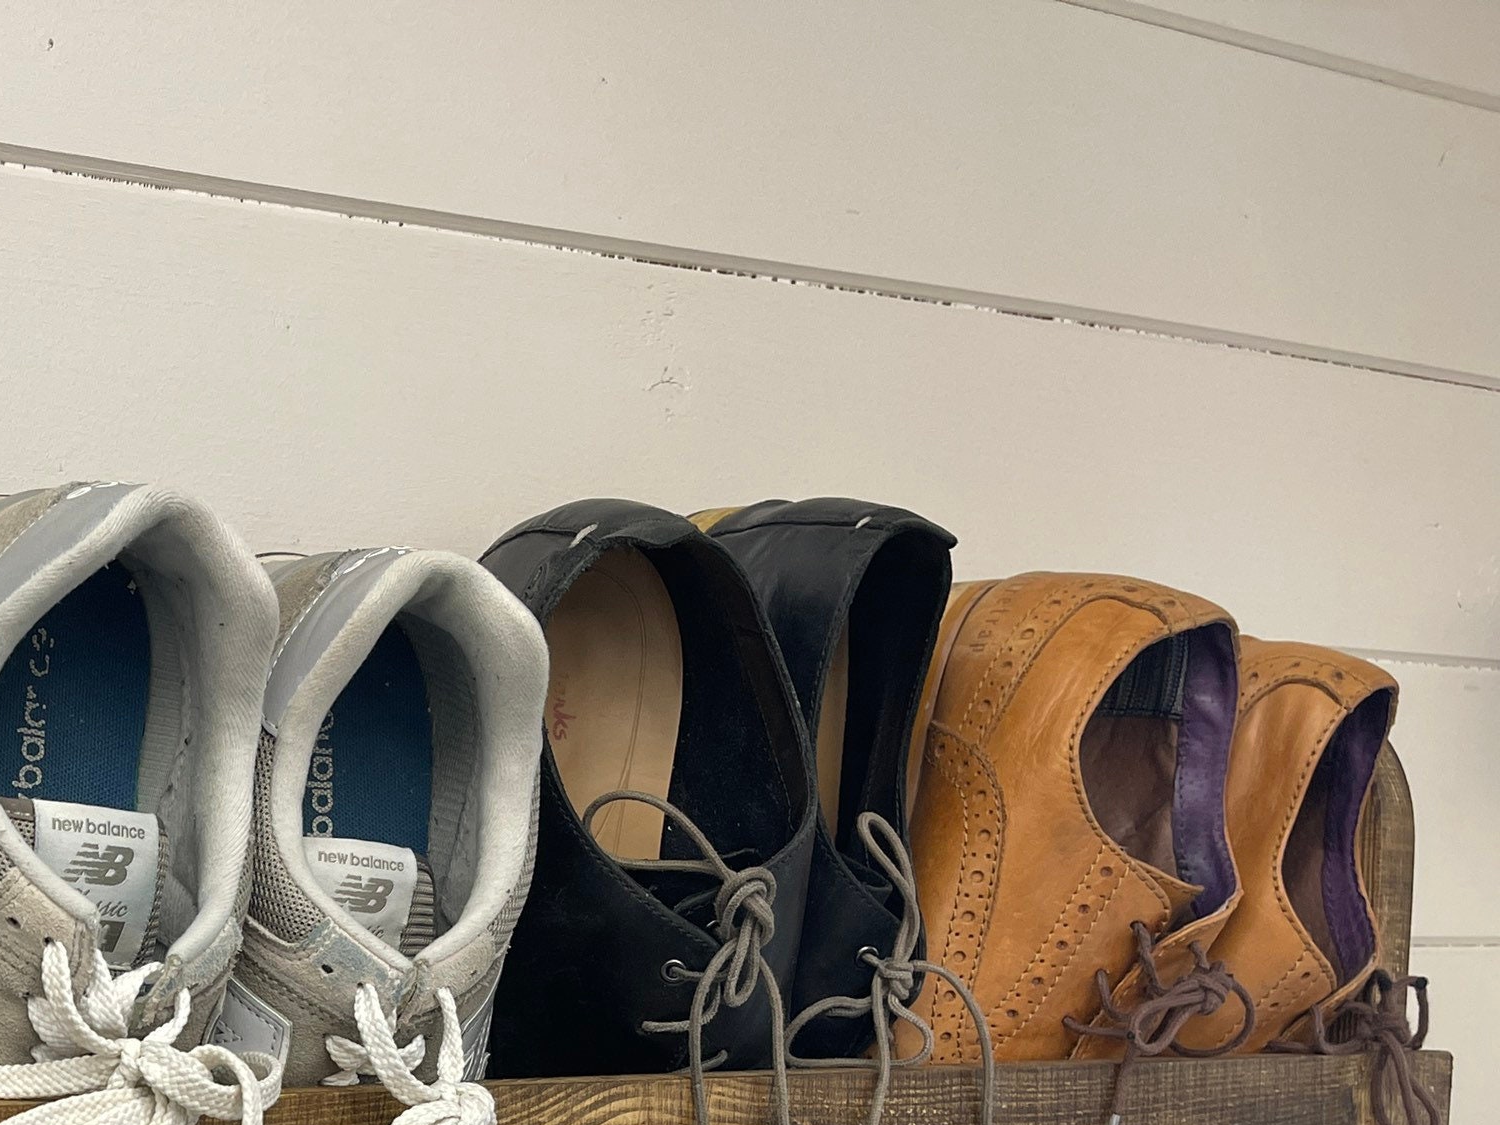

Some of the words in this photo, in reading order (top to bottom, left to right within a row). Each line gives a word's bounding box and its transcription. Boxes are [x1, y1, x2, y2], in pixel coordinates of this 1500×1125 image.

[51, 817, 84, 833] new
[86, 818, 146, 840] balance
[317, 850, 349, 865] new
[350, 852, 405, 872] balance
